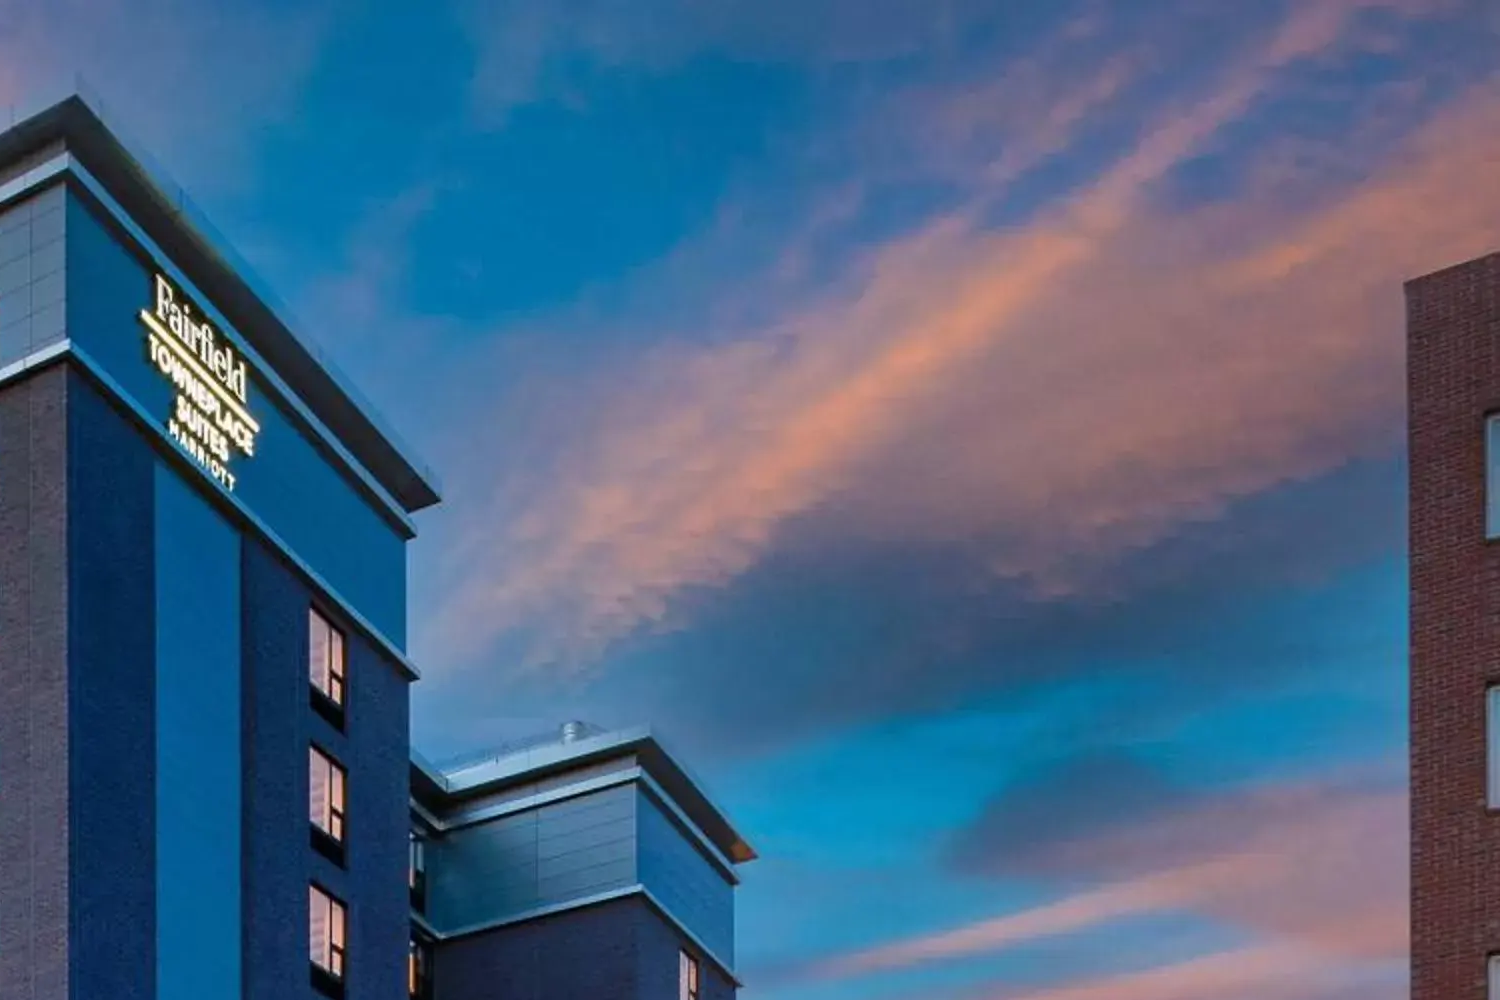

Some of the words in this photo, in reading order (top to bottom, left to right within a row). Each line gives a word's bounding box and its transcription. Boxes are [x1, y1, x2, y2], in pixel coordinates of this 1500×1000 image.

[155, 273, 246, 404] Fairfield
[148, 333, 254, 457] TOWNEPLACE
[176, 394, 229, 462] SUITES
[168, 417, 237, 493] MARRIOTT
